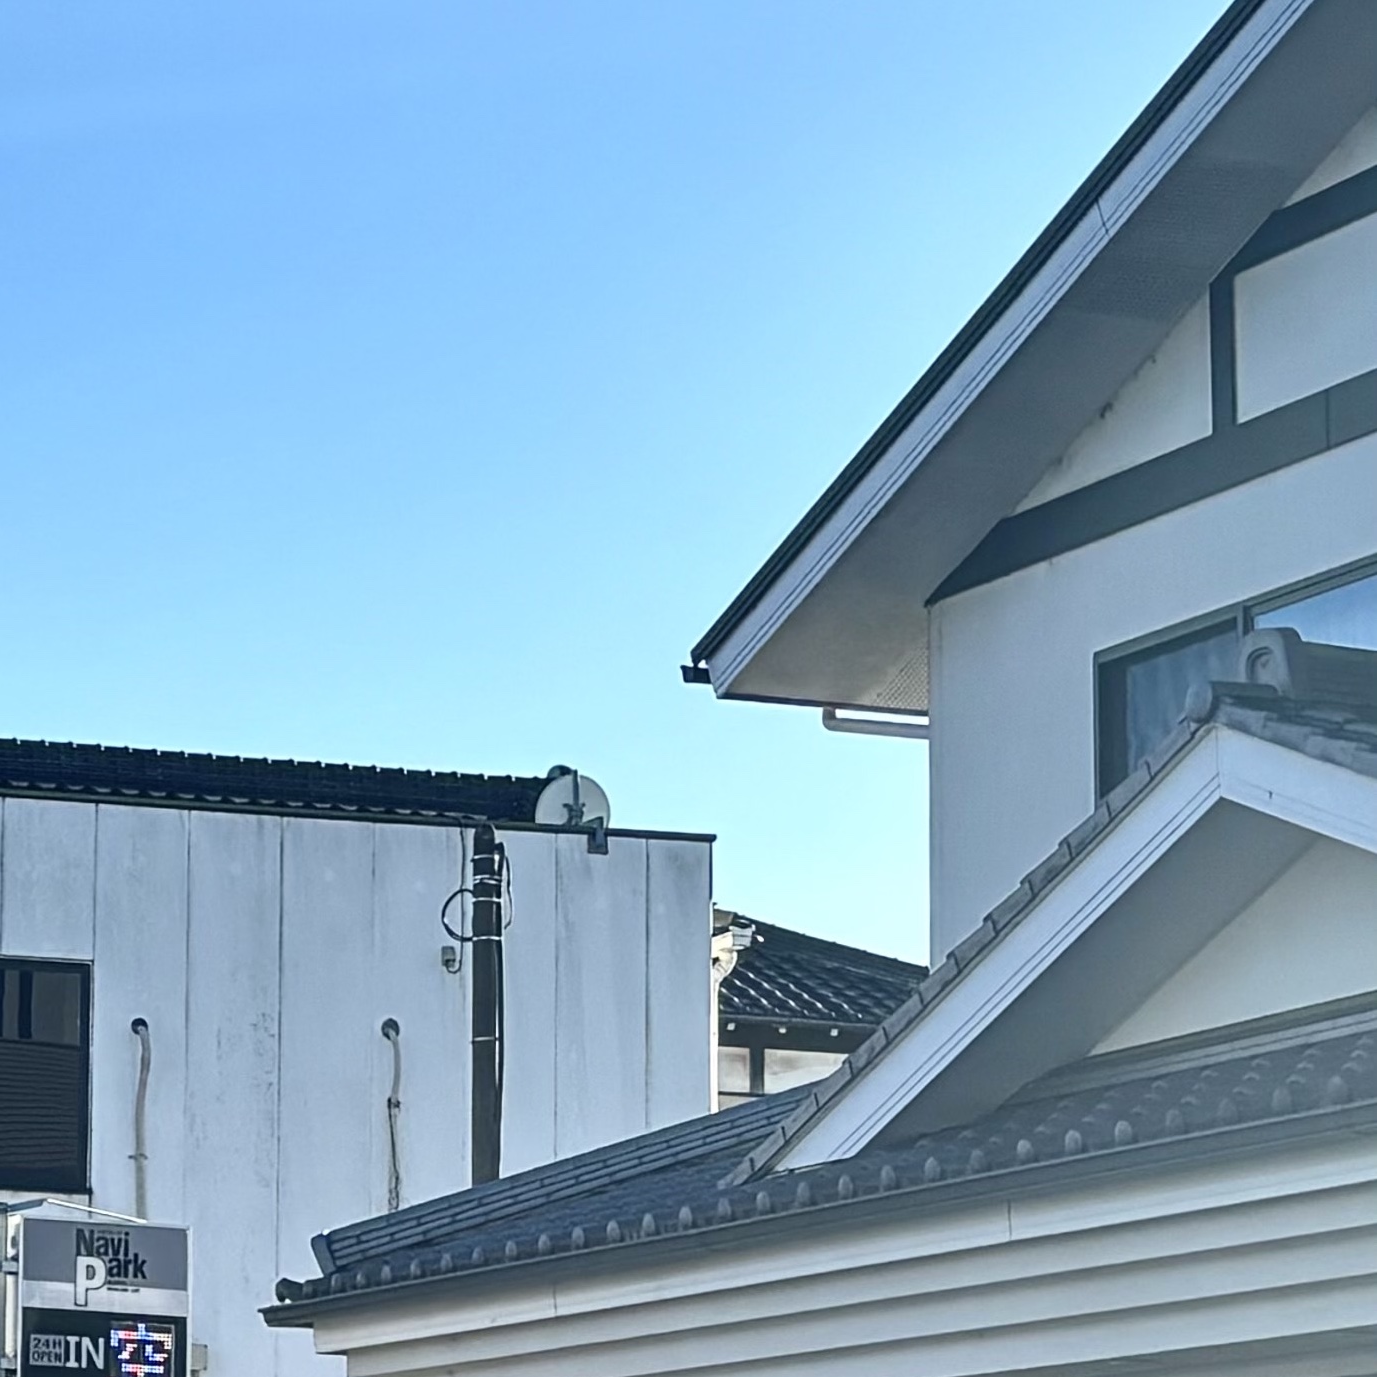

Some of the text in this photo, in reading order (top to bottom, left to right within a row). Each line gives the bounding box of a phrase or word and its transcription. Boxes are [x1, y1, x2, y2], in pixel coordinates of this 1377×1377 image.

[76, 1228, 130, 1258] Navi
[74, 1253, 148, 1307] Park
[31, 1350, 63, 1364] OPEN
[32, 1336, 63, 1350] 24H
[66, 1335, 105, 1370] IN
